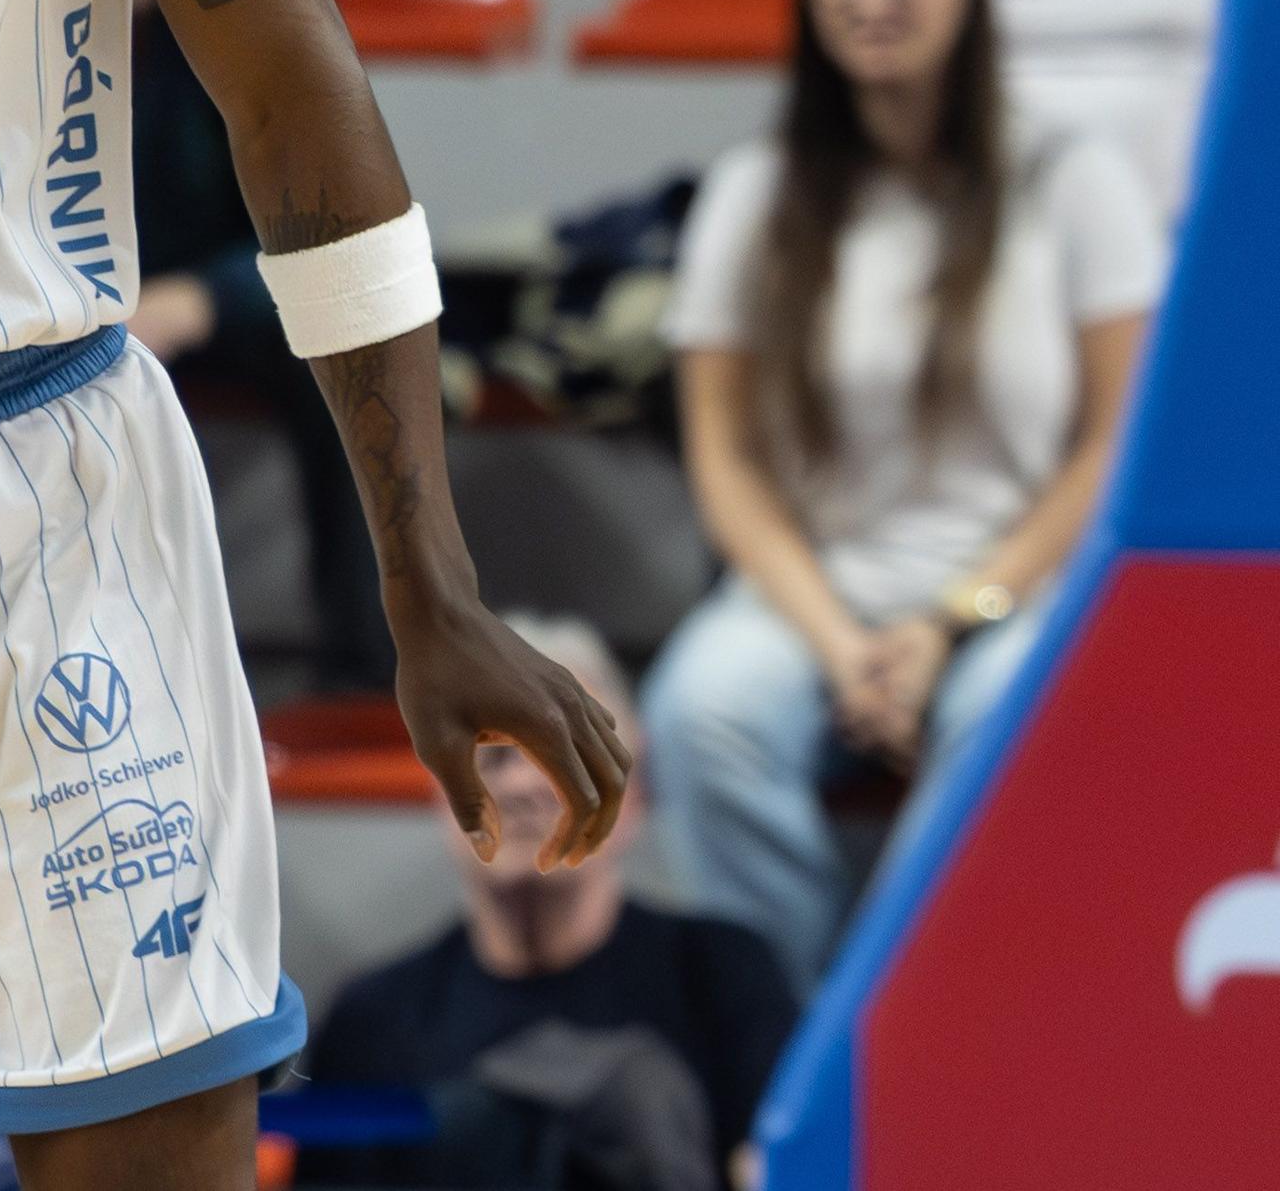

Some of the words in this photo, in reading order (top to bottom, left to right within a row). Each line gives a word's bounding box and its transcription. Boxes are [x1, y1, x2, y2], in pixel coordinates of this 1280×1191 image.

[30, 750, 185, 812] Jodko-Schiewe
[42, 845, 105, 878] Auto
[132, 891, 207, 958] 4F
